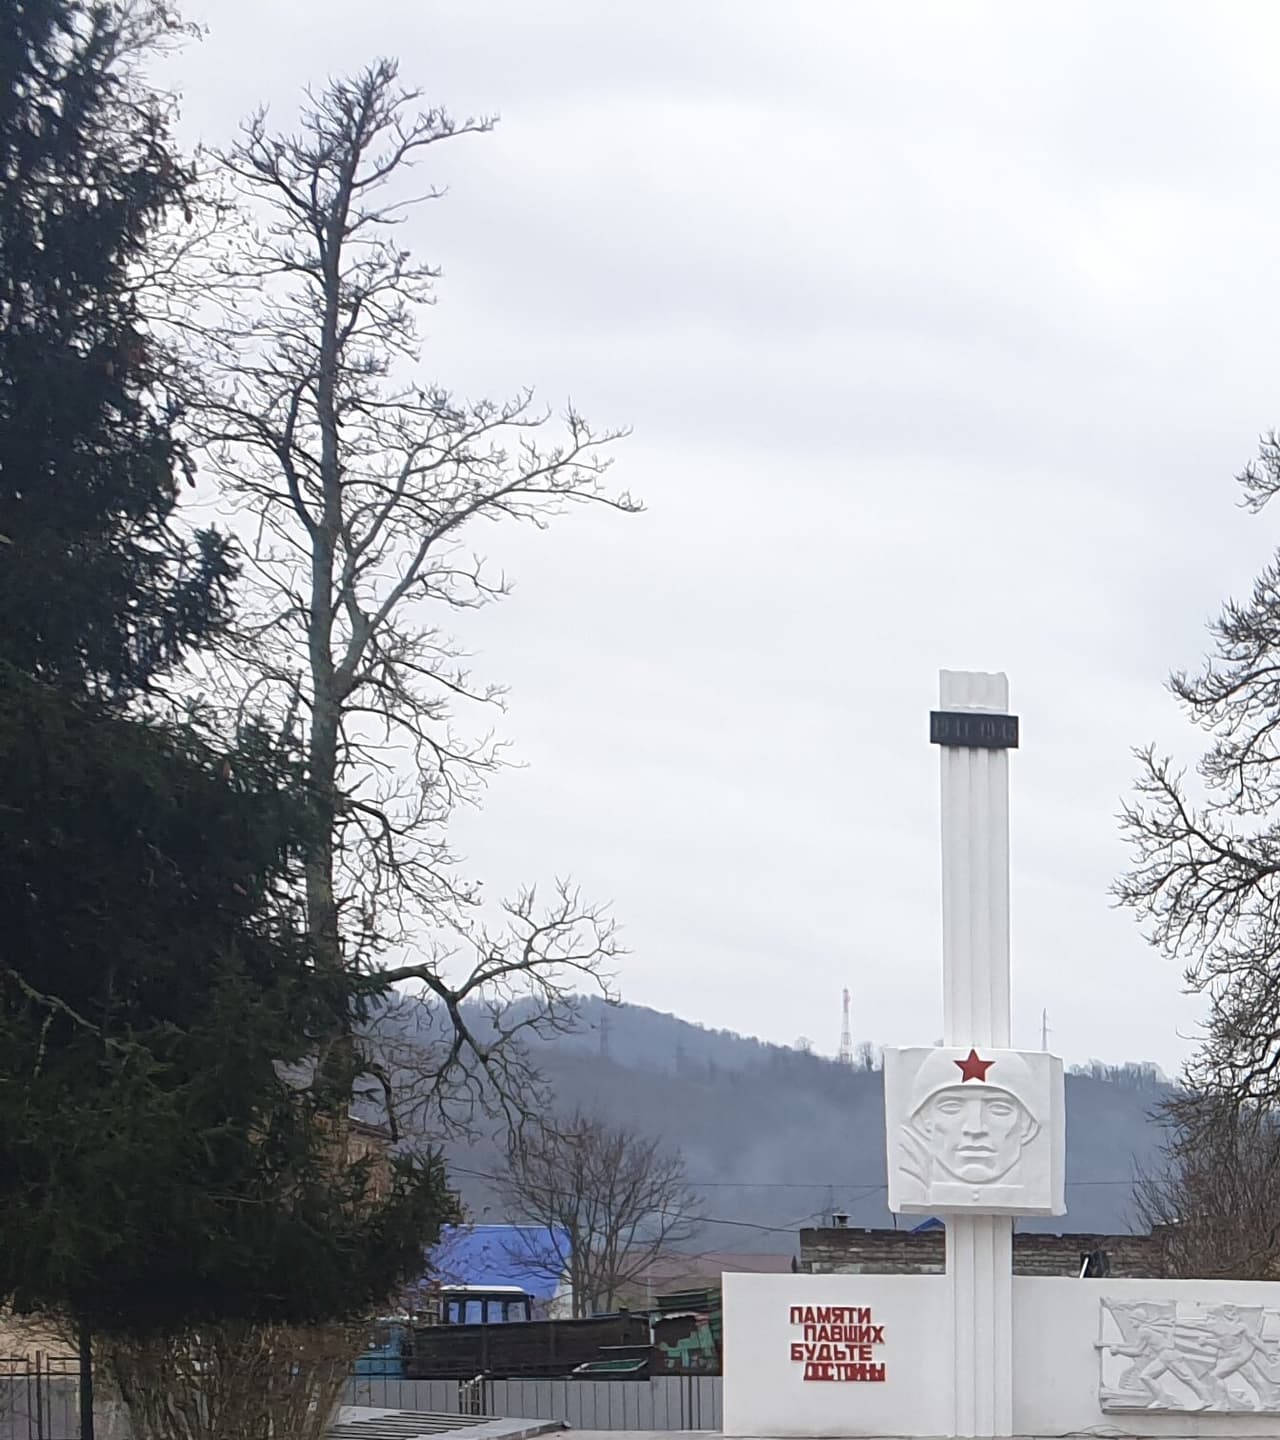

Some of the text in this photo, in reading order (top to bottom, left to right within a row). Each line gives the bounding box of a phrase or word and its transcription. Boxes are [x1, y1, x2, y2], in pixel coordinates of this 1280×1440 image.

[790, 1306, 871, 1324] ПАМЯТИ
[804, 1325, 885, 1343] ПАВШИХ
[790, 1343, 873, 1361] БУДЬТЕ
